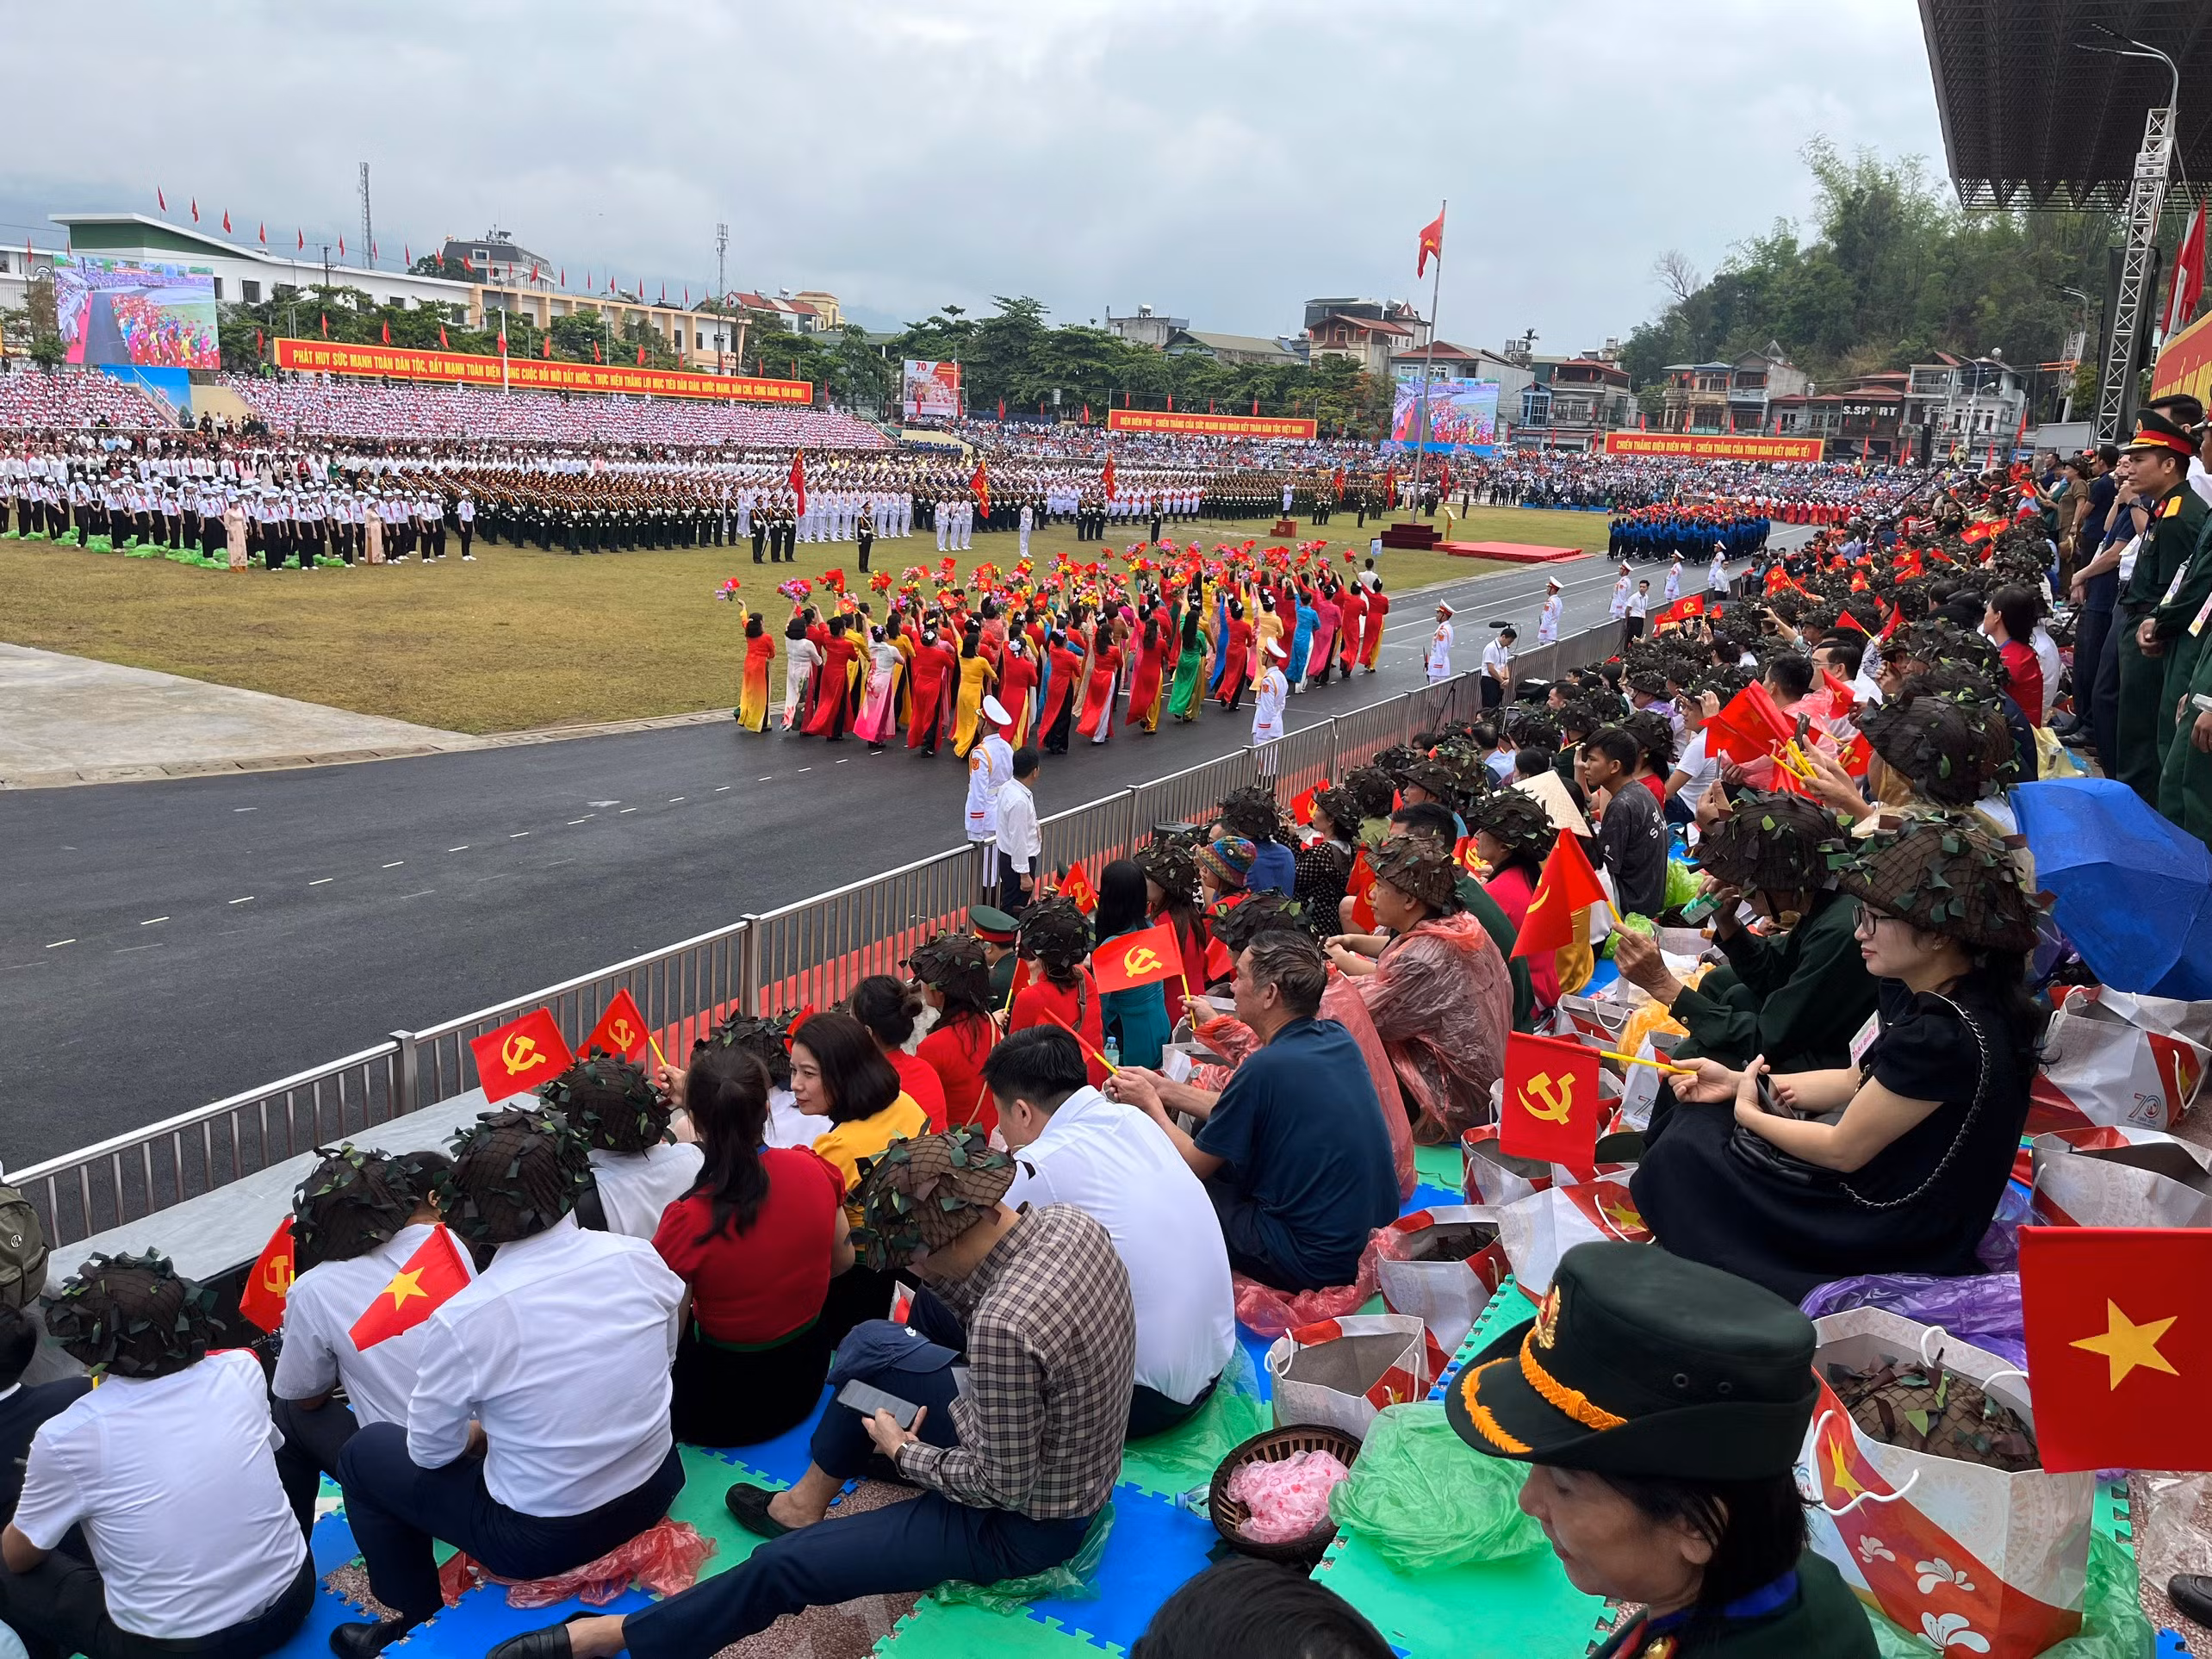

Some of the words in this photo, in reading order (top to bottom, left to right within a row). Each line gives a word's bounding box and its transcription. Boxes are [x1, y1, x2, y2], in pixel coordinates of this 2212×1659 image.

[293, 348, 313, 363] PHÁT
[315, 351, 330, 365] HUY
[332, 351, 348, 366] SỨC
[350, 354, 372, 370] MẠNH
[374, 354, 393, 370] TOÀN
[395, 356, 410, 371] DÂN
[412, 357, 427, 375] TỘC,
[429, 356, 443, 373] ĐẨY
[444, 362, 465, 377] MẠNH
[467, 362, 484, 376] TOÀN
[486, 363, 500, 380] DIỆN
[505, 365, 519, 379] ÔNG
[521, 366, 537, 382] CUỘC
[539, 366, 549, 381] ĐỔI
[550, 369, 562, 382] MỚI
[563, 368, 574, 382] ĐẤT
[575, 370, 593, 385] NƯỚC,
[595, 373, 608, 388] THỰC
[916, 362, 927, 371] 70
[1842, 406, 1898, 417] S.SPRT
[1616, 438, 1633, 450] CHIẾN
[1633, 438, 1652, 450] THẮNG
[1652, 439, 1666, 453] ĐIỆN
[1666, 440, 1680, 451] BIÊN
[1680, 439, 1692, 452] PHỦ
[1696, 440, 1712, 453] CHIẾN
[1713, 441, 1731, 454] THẮNG
[1732, 442, 1743, 455] CỦA
[1758, 444, 1774, 456] ĐOÀN
[1774, 443, 1785, 457] KẾT
[1785, 443, 1800, 457] QUỐC
[1633, 1095, 1656, 1117] 7
